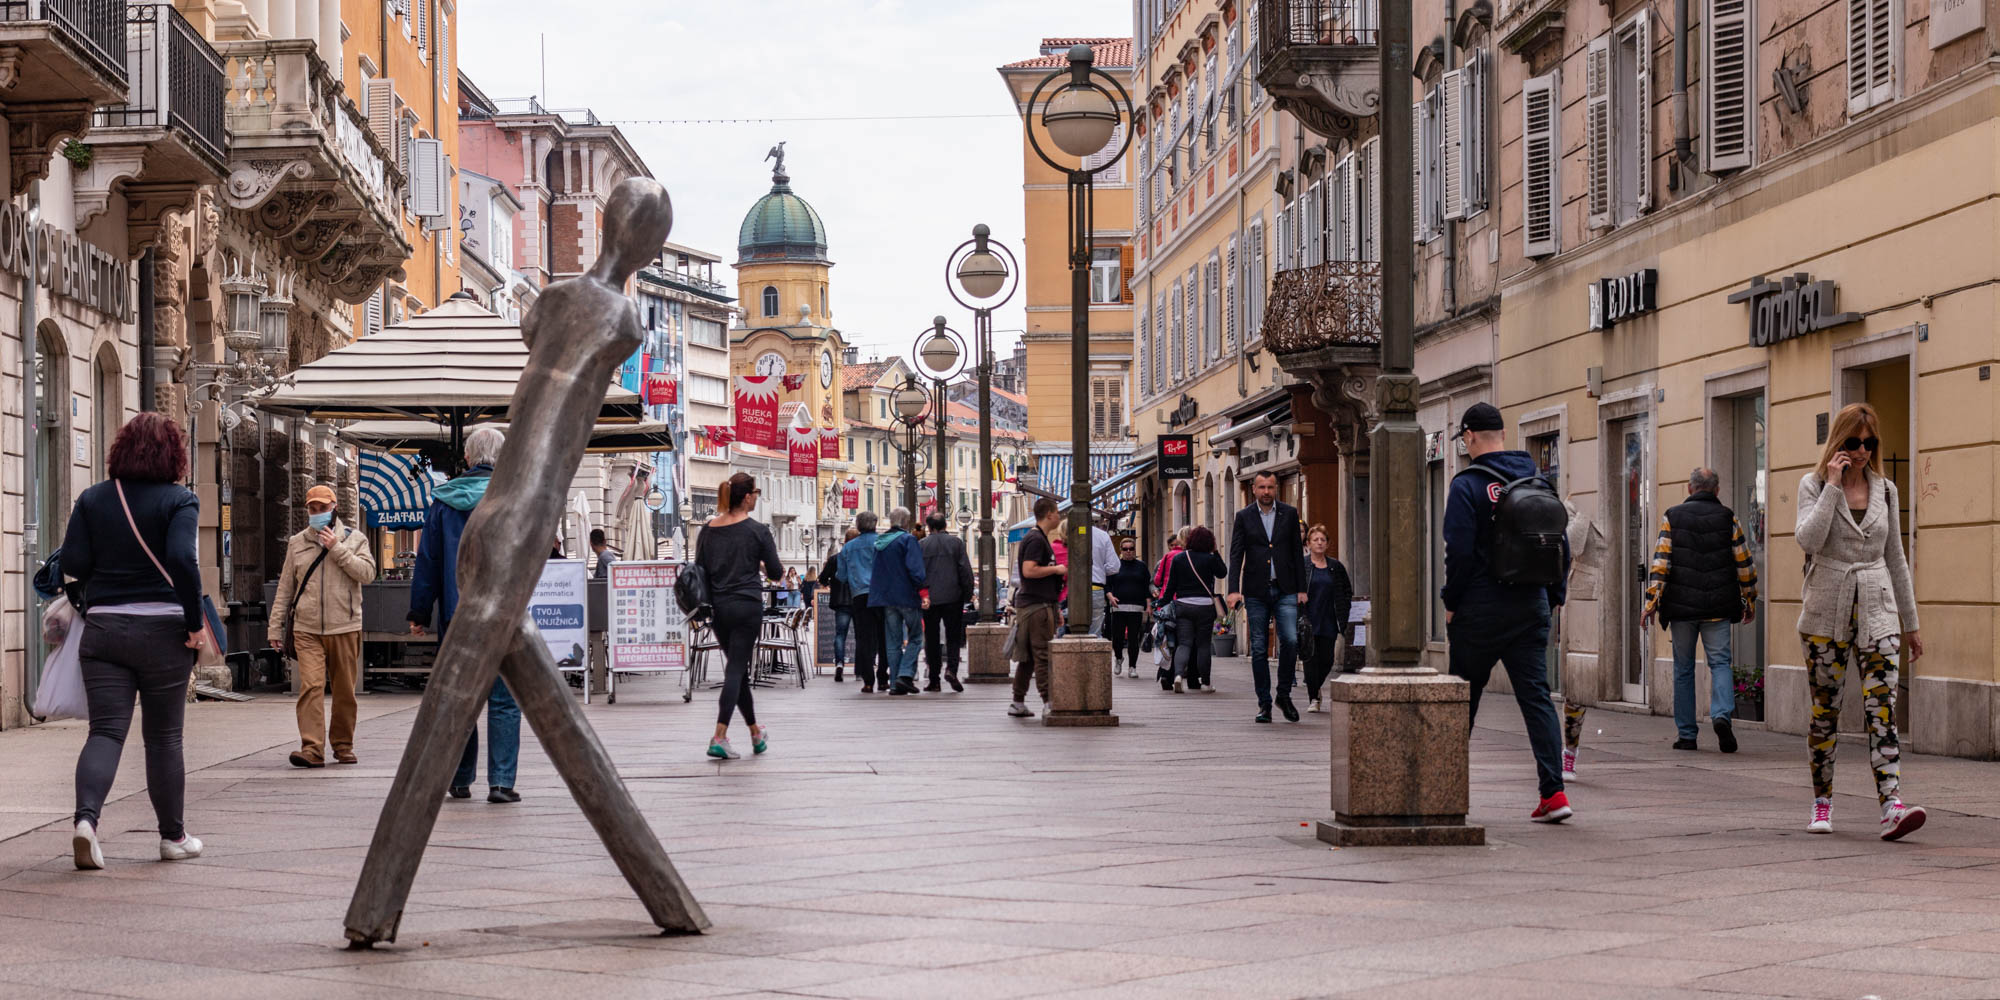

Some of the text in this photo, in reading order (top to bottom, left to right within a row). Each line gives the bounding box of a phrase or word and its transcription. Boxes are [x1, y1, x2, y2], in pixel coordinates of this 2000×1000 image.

[37, 219, 57, 290] OF
[55, 229, 135, 325] BENETTON
[1607, 269, 1646, 320] EDIT
[1728, 272, 1864, 347] Torbica
[742, 408, 773, 419] RIJEKA
[377, 511, 425, 523] ZLATAR
[554, 581, 571, 589] odjel
[641, 590, 655, 598] 745
[536, 608, 562, 616] TVOJA
[536, 617, 579, 626] KNJIŽNICA
[617, 645, 683, 654] EXCHANGE
